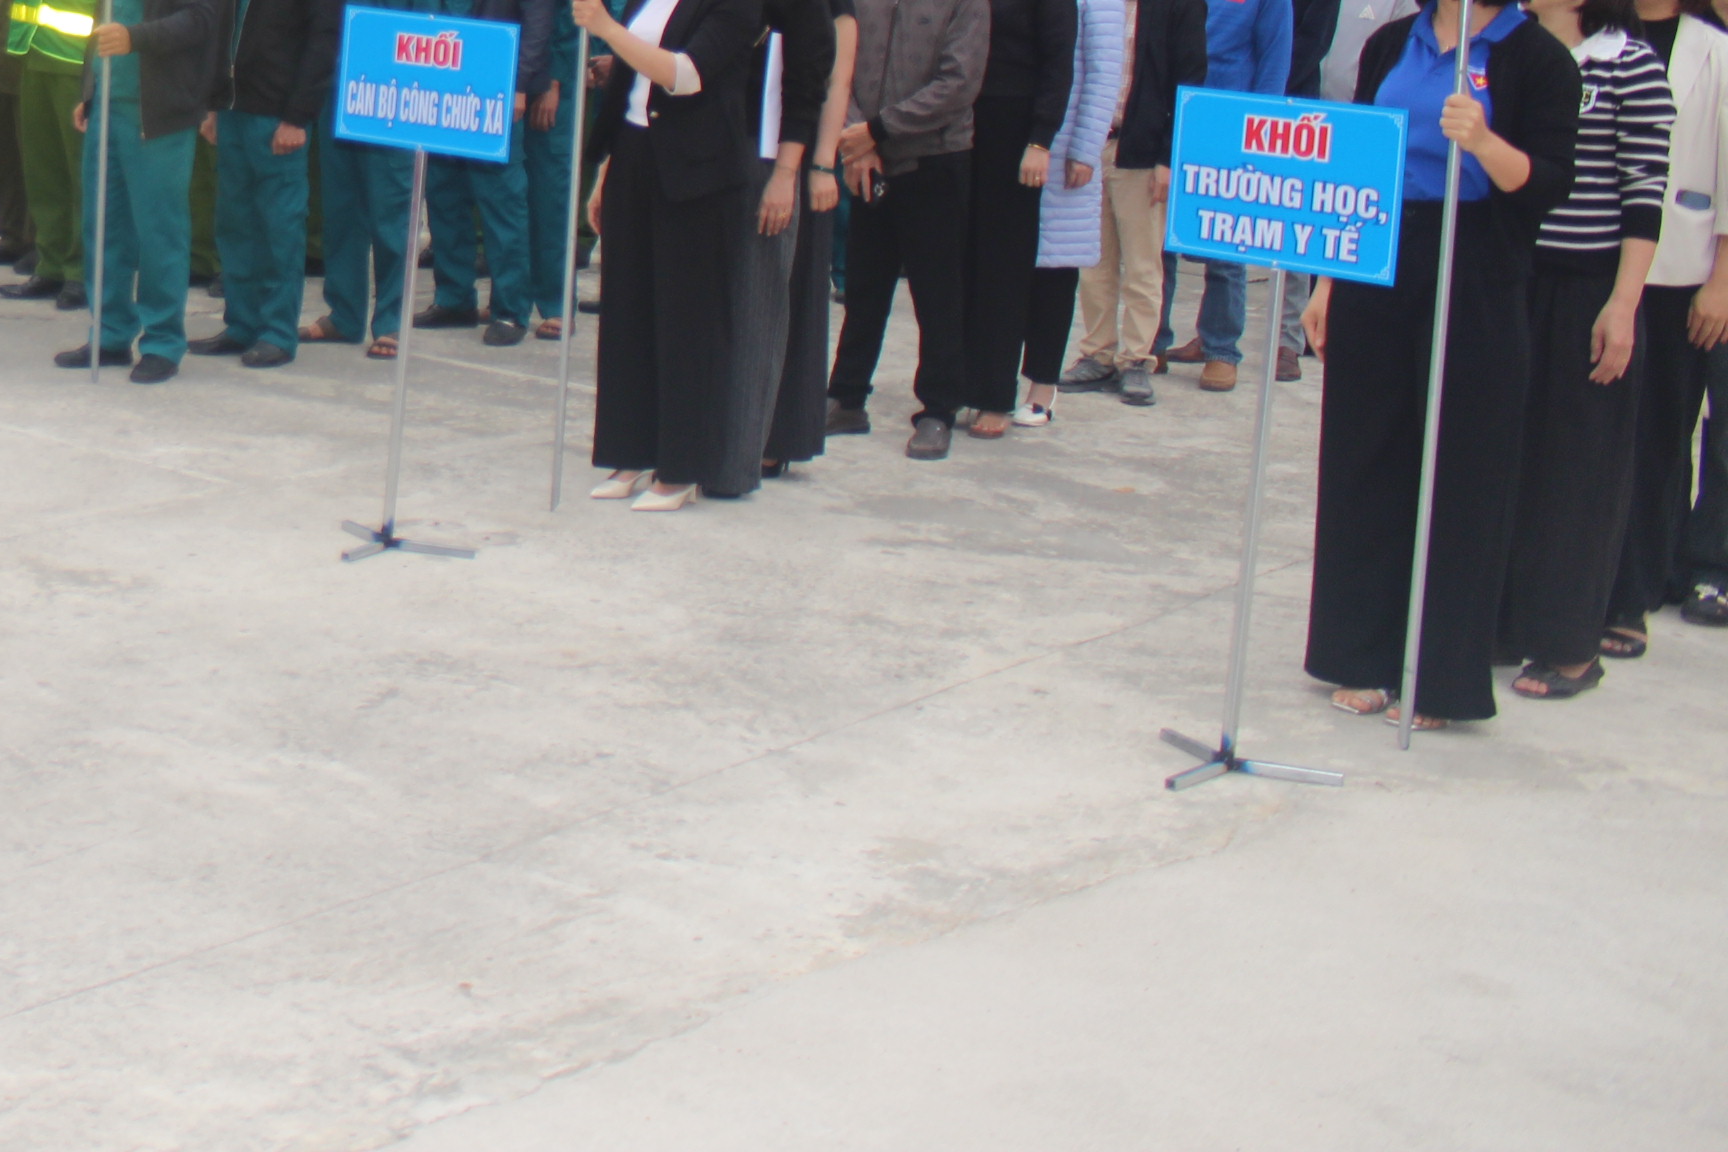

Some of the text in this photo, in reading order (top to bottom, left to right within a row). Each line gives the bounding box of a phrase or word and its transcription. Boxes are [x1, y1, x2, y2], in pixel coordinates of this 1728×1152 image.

[395, 31, 463, 70] KHỐI
[346, 74, 505, 135] CÁN BỘ CÔNG CHỨC XÃ
[1241, 112, 1332, 163] KHỐI
[1182, 163, 1389, 225] TRƯỜNG HỌC,
[1197, 209, 1363, 263] TRẠM Y TẾ
